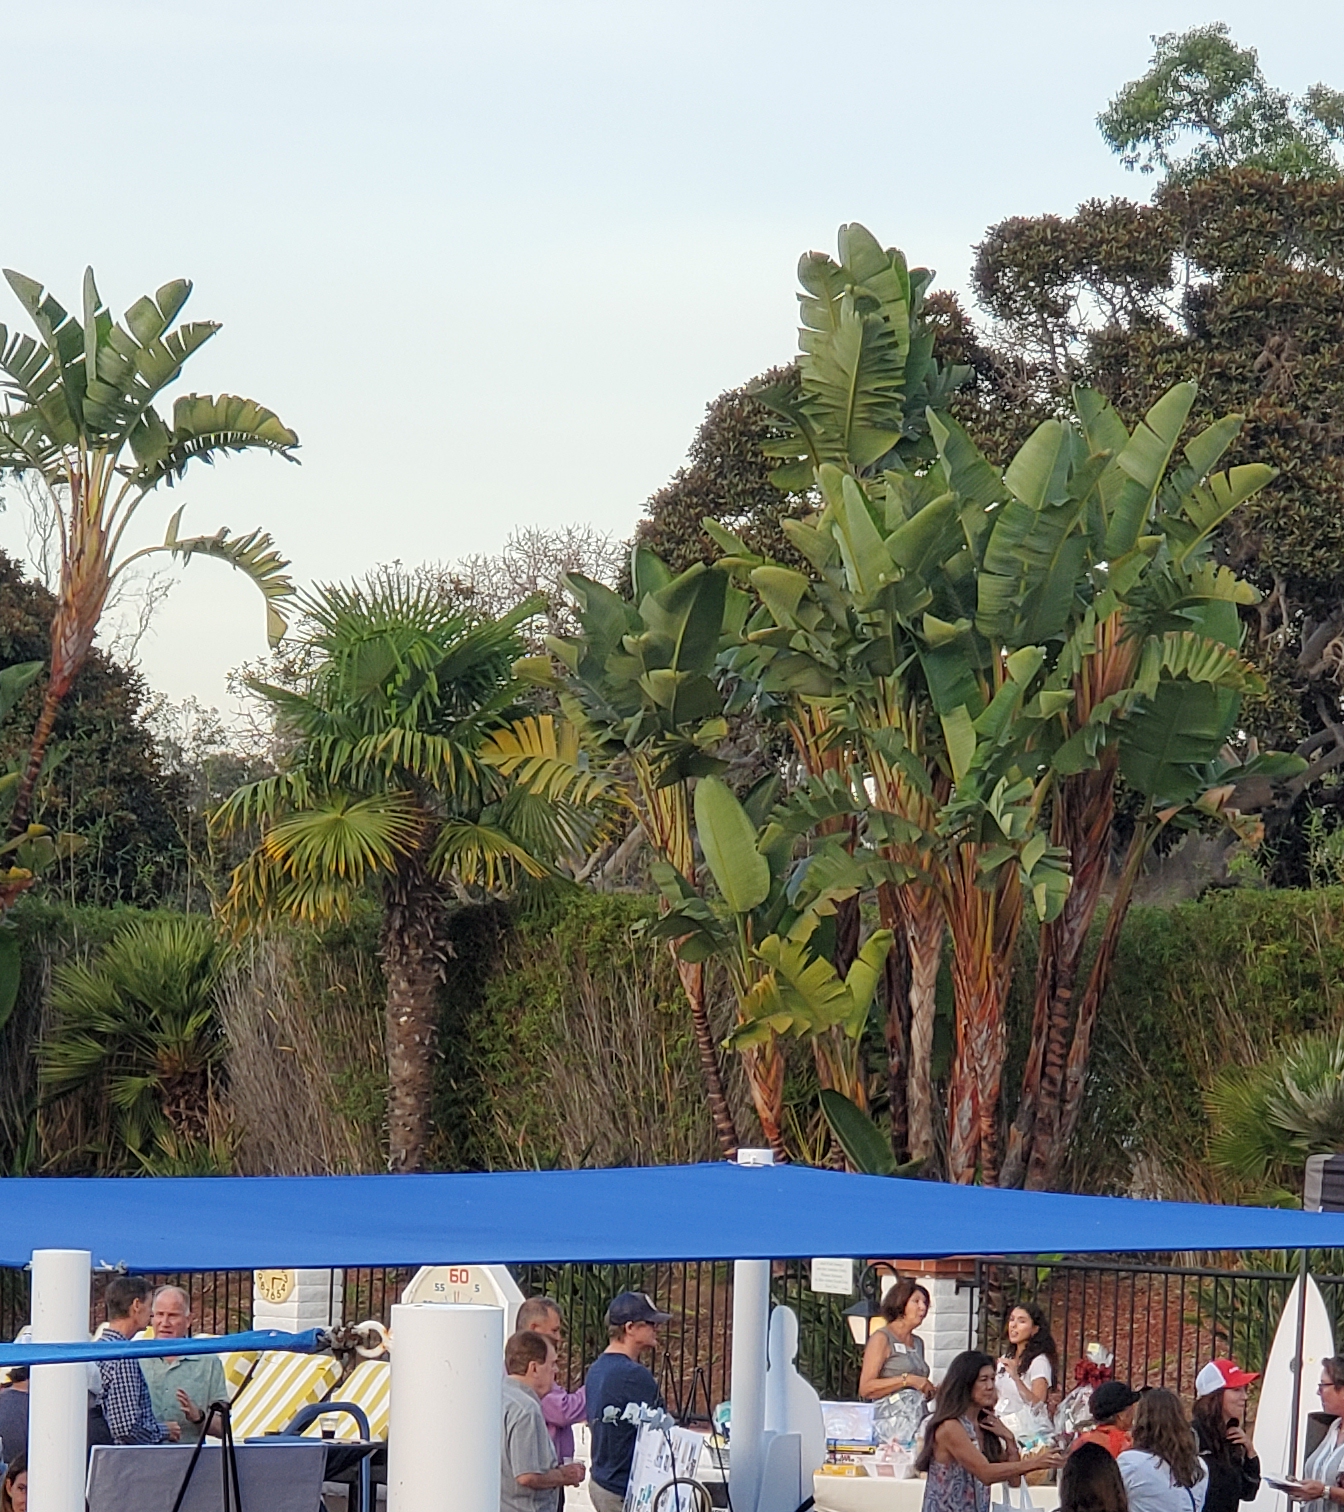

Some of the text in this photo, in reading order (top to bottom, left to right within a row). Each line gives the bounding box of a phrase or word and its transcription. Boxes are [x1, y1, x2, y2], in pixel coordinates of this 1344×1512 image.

[450, 1268, 469, 1284] 60
[434, 1283, 445, 1292] 55
[474, 1284, 480, 1293] 5
